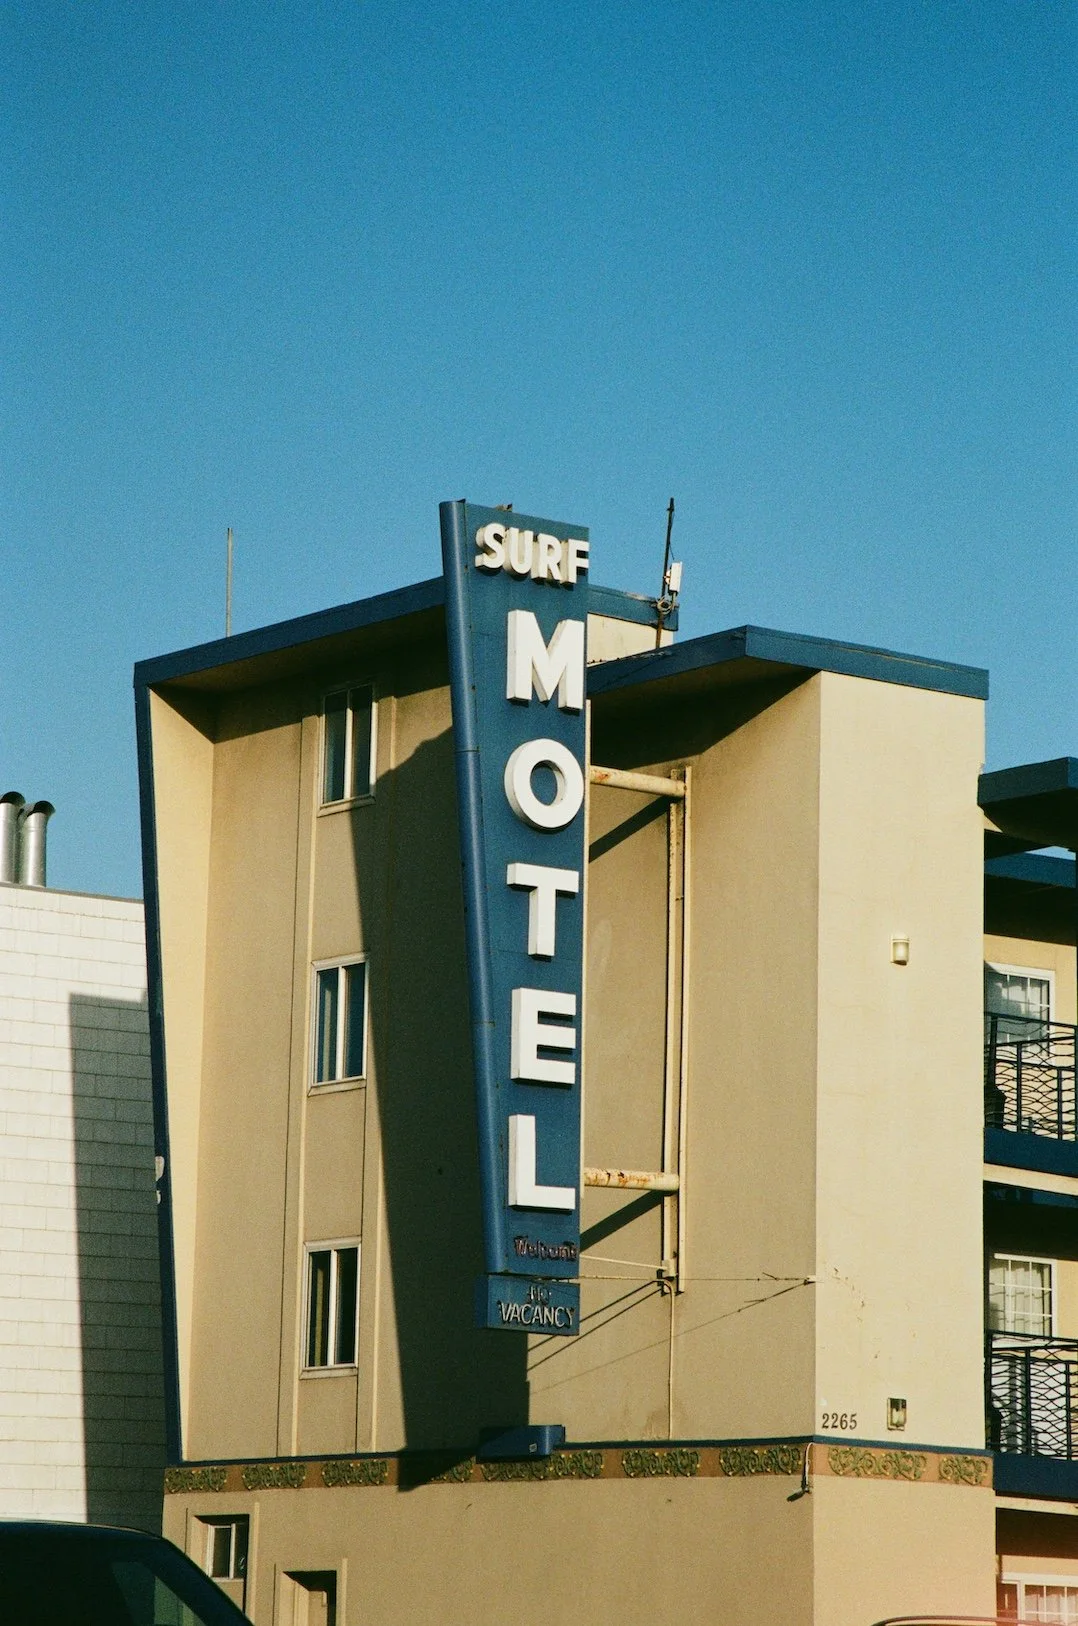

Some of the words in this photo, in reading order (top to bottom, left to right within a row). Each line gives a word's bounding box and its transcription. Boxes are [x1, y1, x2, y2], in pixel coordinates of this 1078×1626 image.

[475, 523, 589, 584] SURF
[504, 609, 584, 1210] MOTEL
[500, 1302, 575, 1328] VACANCY
[822, 1413, 857, 1429] 2265
